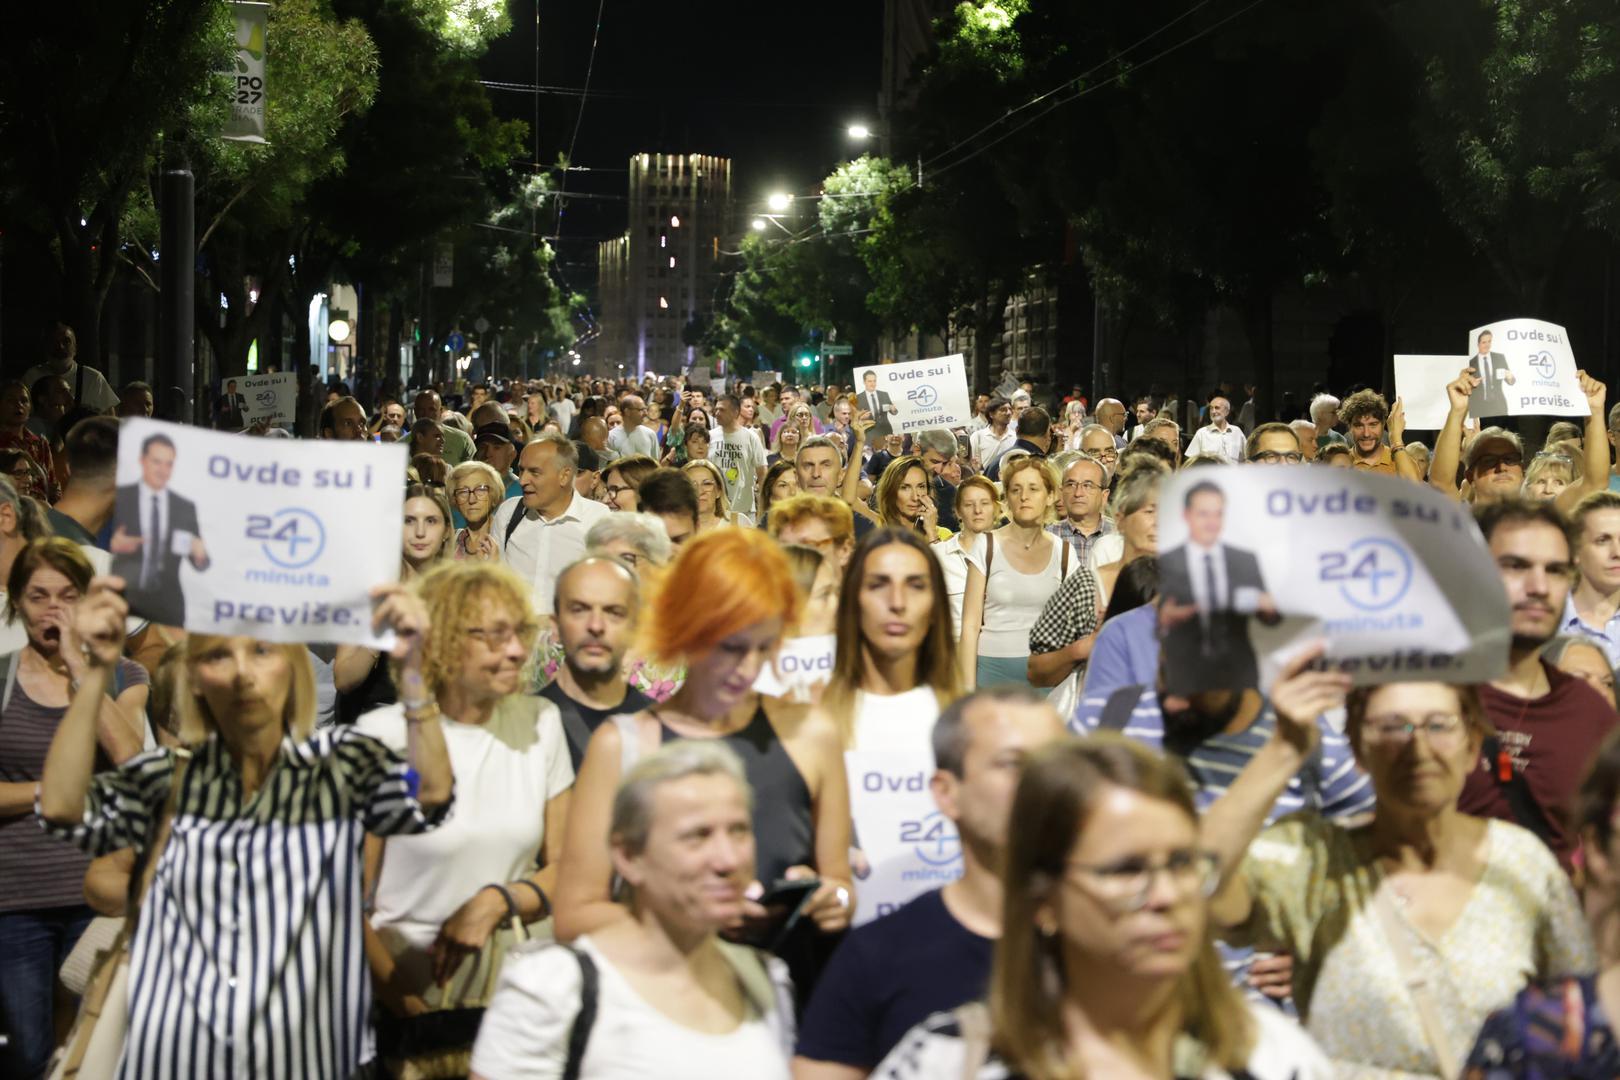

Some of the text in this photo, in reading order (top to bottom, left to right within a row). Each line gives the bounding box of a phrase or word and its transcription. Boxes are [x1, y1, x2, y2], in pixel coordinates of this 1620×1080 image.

[237, 75, 263, 91] PO
[237, 90, 263, 105] 27
[1507, 329, 1544, 341] Ovde
[1546, 333, 1558, 344] su
[888, 364, 951, 382] Ovde su i
[244, 379, 269, 388] Ovde
[1531, 379, 1560, 388] minuta
[1520, 394, 1575, 409] previše.
[911, 405, 943, 415] minuta
[901, 414, 958, 430] previše.
[716, 440, 743, 451] Three
[714, 449, 744, 461] stripe
[207, 454, 373, 489] Ovde su i
[1266, 488, 1378, 518] Ovde
[1390, 498, 1441, 524] su
[244, 567, 331, 588] minuta
[212, 599, 362, 627] previše.
[1322, 613, 1424, 634] minuta
[780, 651, 833, 674] Ovd
[1310, 645, 1467, 674] reviše.
[863, 771, 933, 793] Ovd
[901, 867, 963, 883] minut
